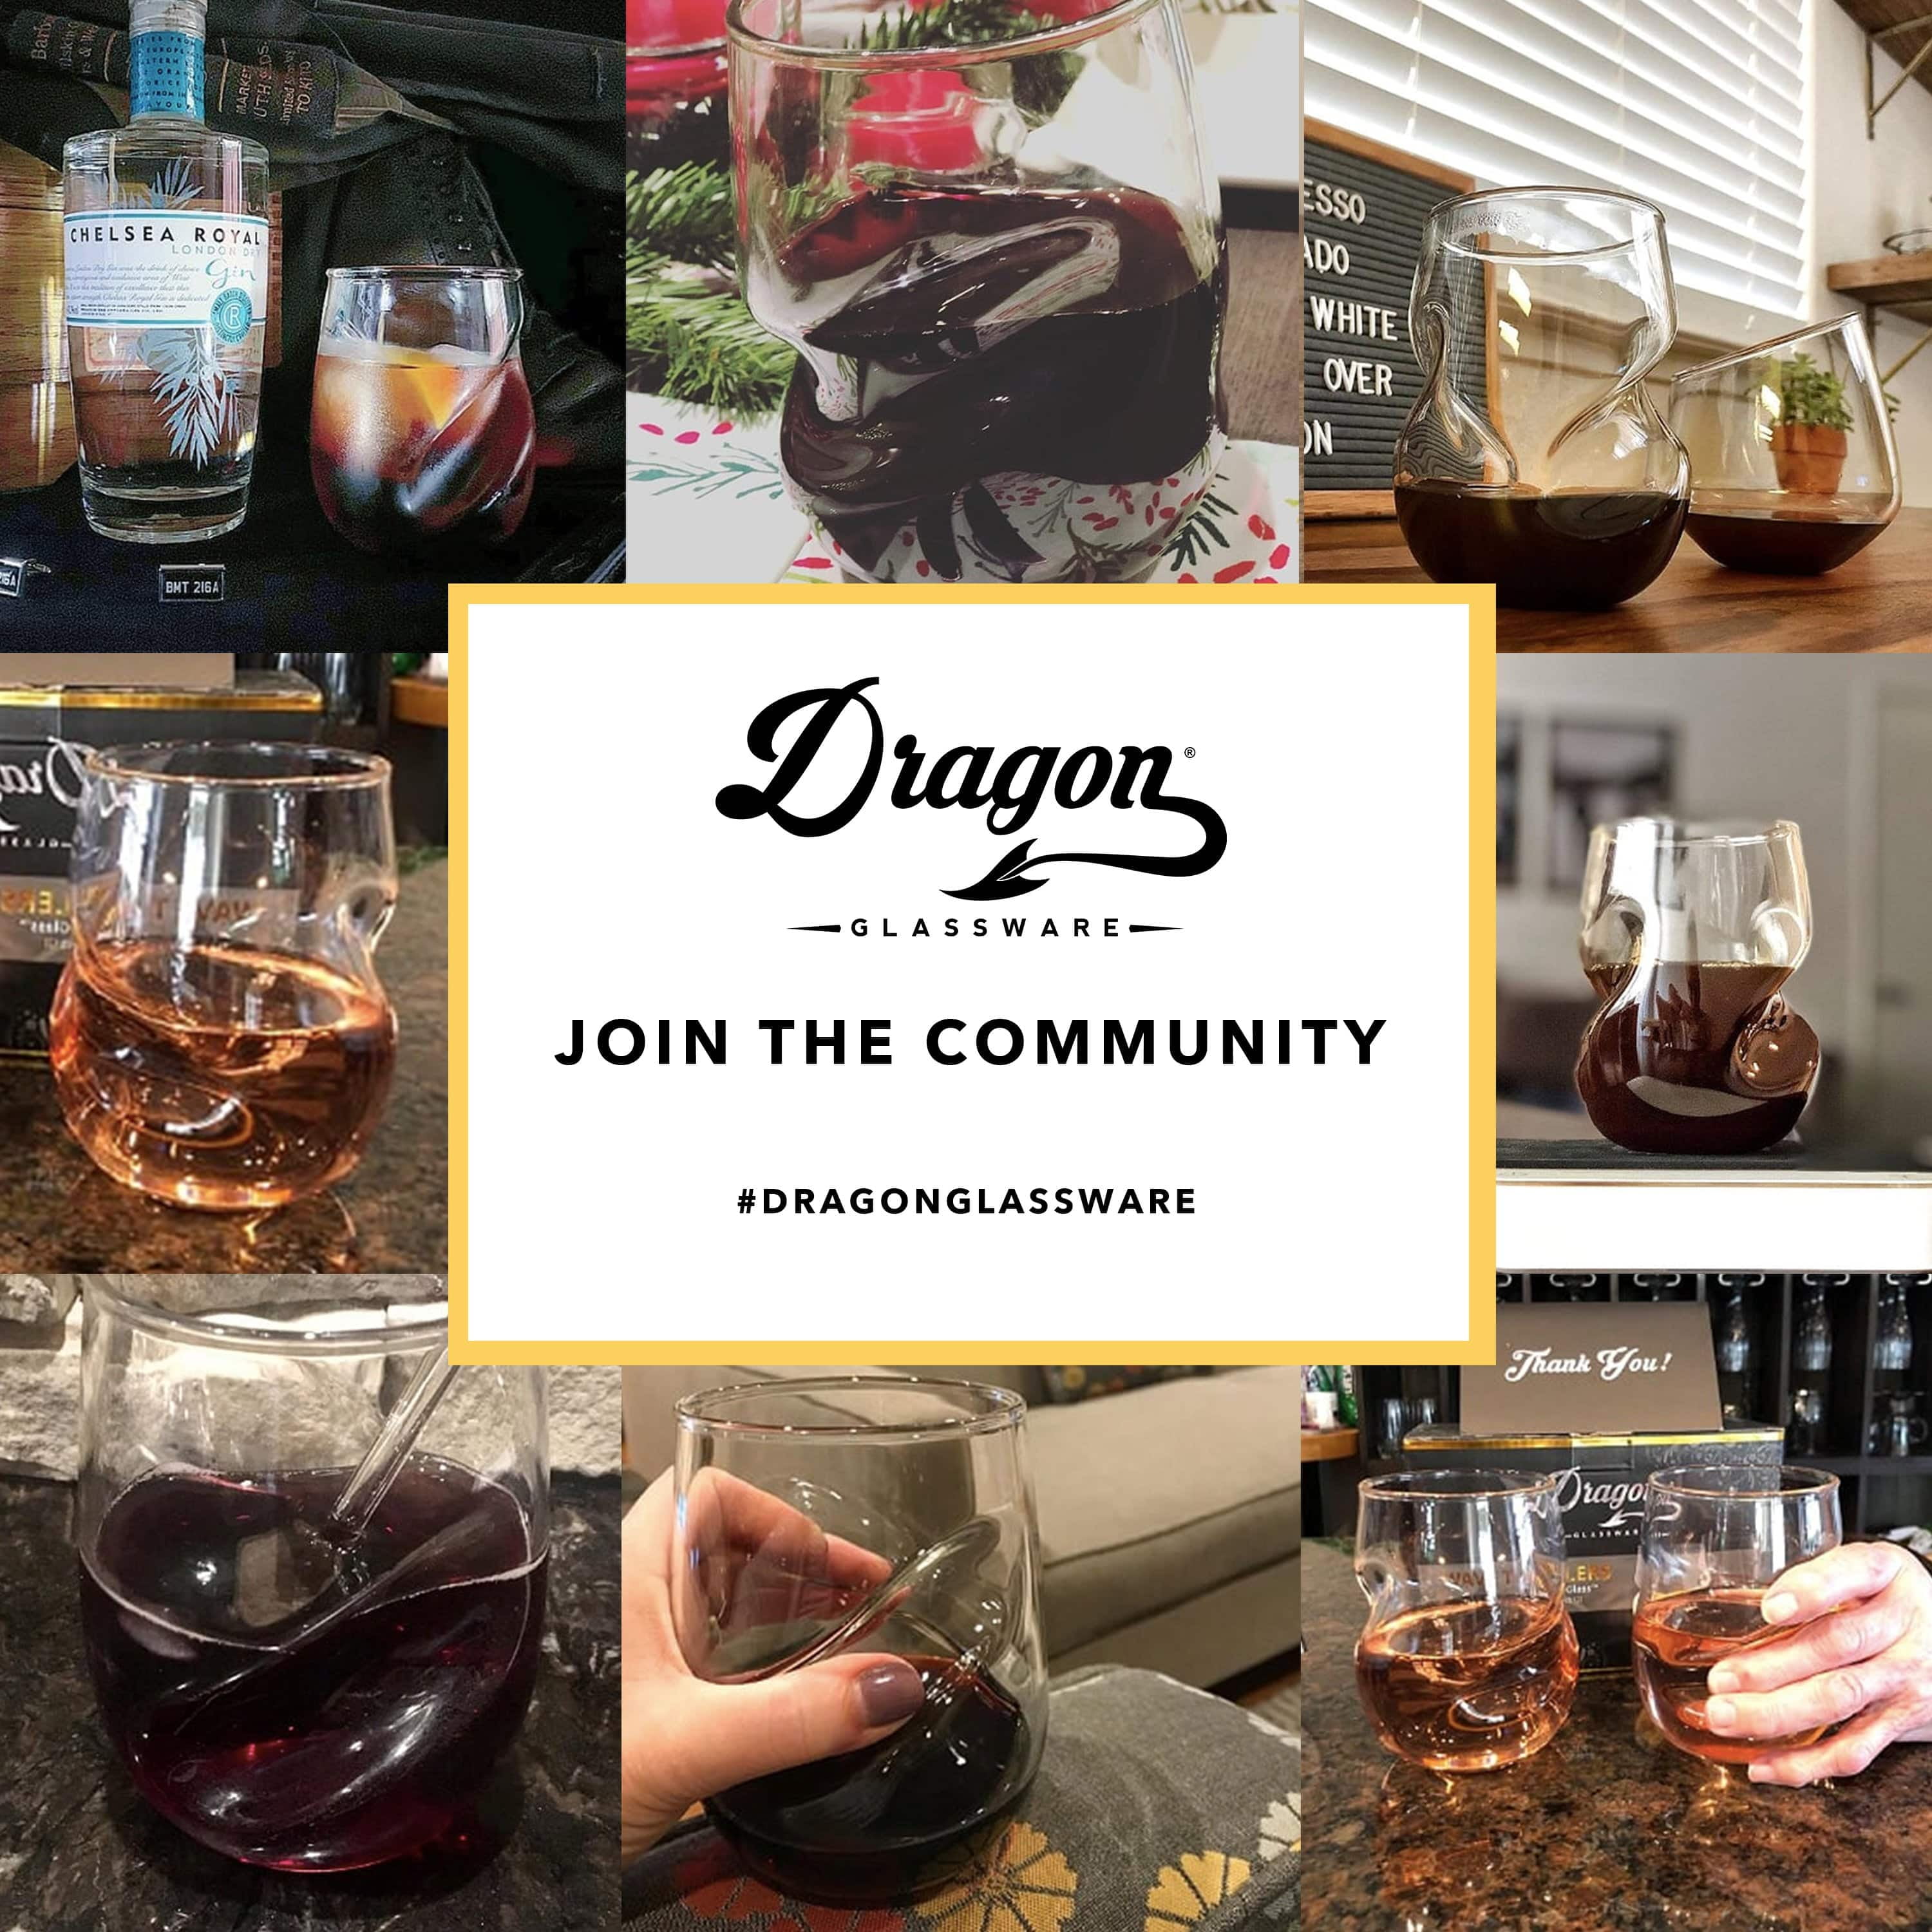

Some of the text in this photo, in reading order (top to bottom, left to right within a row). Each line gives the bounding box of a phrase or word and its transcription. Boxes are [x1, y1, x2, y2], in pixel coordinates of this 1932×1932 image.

[70, 225, 260, 245] CHELSEA ROYAL
[171, 244, 261, 256] LONDON DRY
[1304, 234, 1350, 276] ADO
[205, 258, 256, 289] Gin
[1310, 296, 1398, 341] WHITE
[1323, 358, 1393, 396] OVER
[166, 581, 219, 593] BMT 216A
[1504, 1346, 1673, 1382] Thank You!
